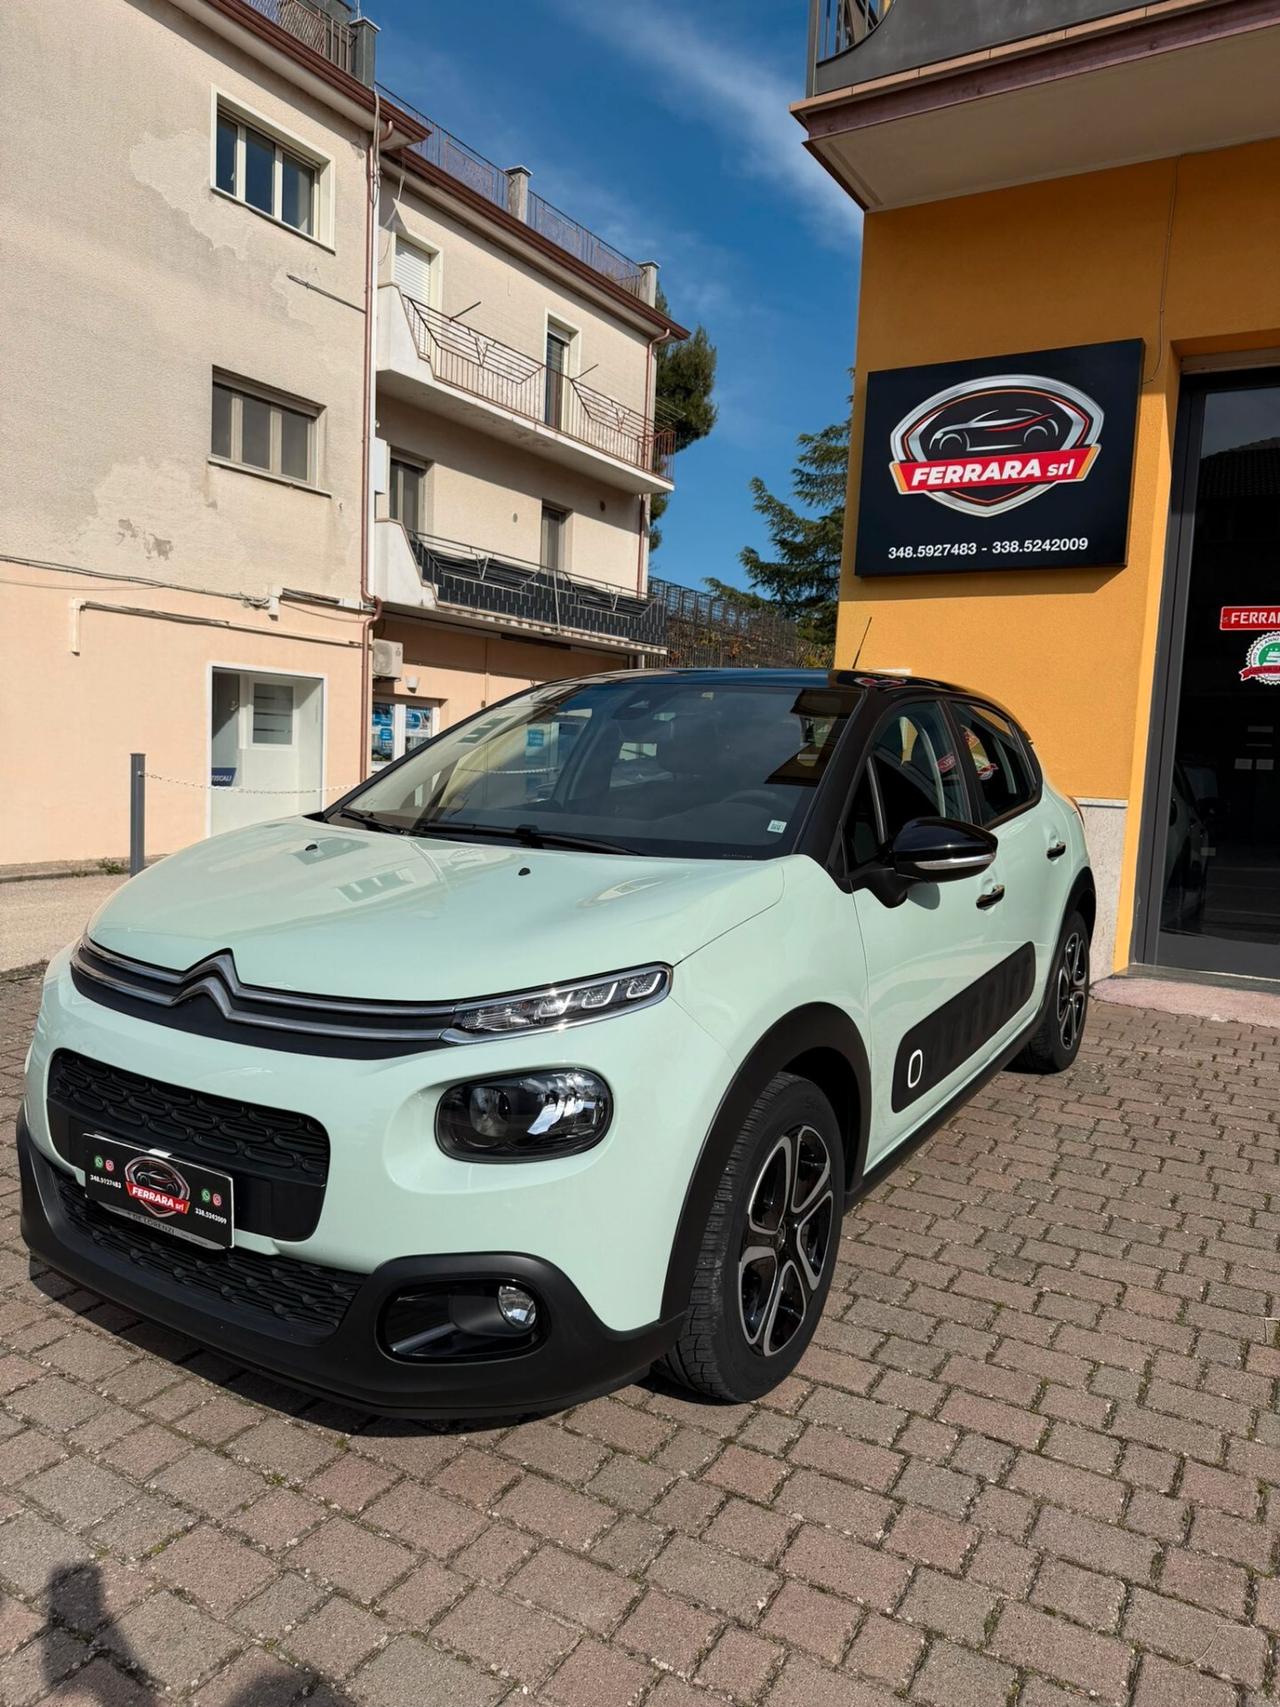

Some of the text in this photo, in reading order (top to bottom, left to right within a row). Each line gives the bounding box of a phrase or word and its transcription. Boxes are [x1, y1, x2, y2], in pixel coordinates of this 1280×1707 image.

[911, 458, 1075, 486] FERRARA srl
[888, 542, 977, 559] 348.5927483
[992, 537, 1088, 555] 338.5242009
[1230, 611, 1280, 624] FERRA
[132, 1186, 185, 1212] FERRARA srl
